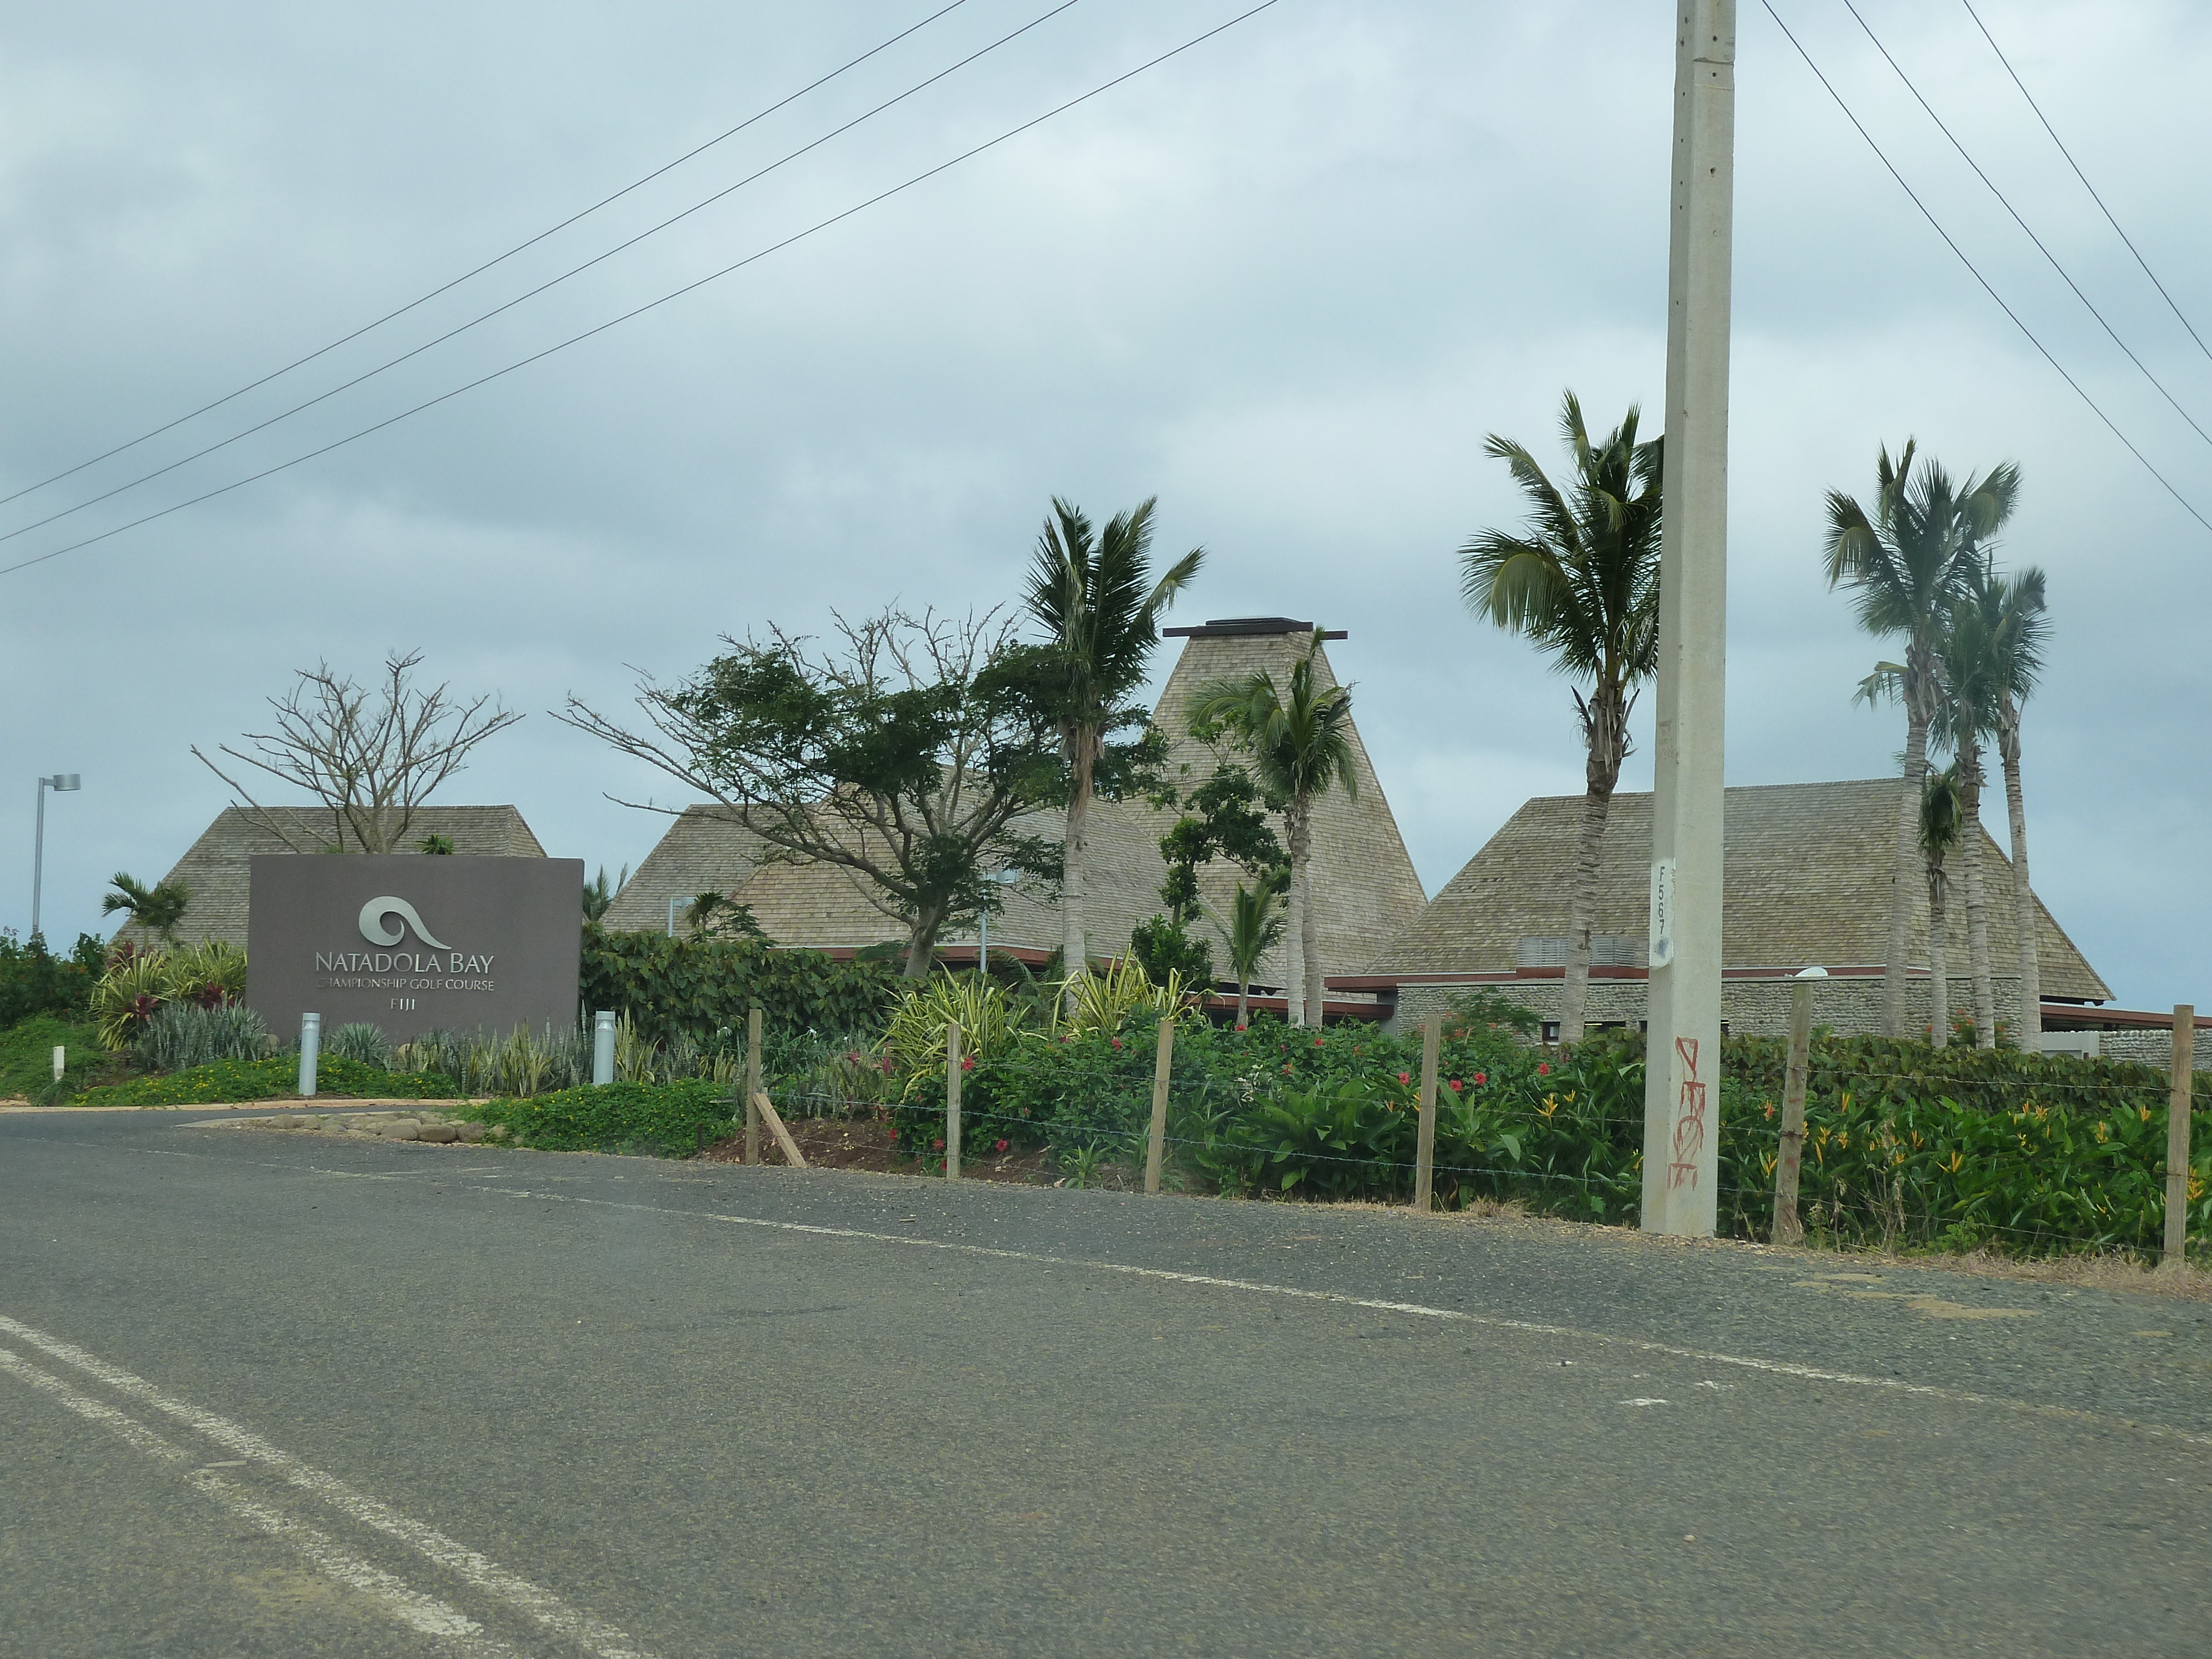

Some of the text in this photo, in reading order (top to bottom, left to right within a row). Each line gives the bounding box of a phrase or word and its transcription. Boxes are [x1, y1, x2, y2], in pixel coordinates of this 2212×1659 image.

[316, 952, 494, 974] NATADOLA BAY
[317, 978, 494, 991] CHAMPIONSHIP GOLF COURSE
[390, 998, 415, 1011] FIJI
